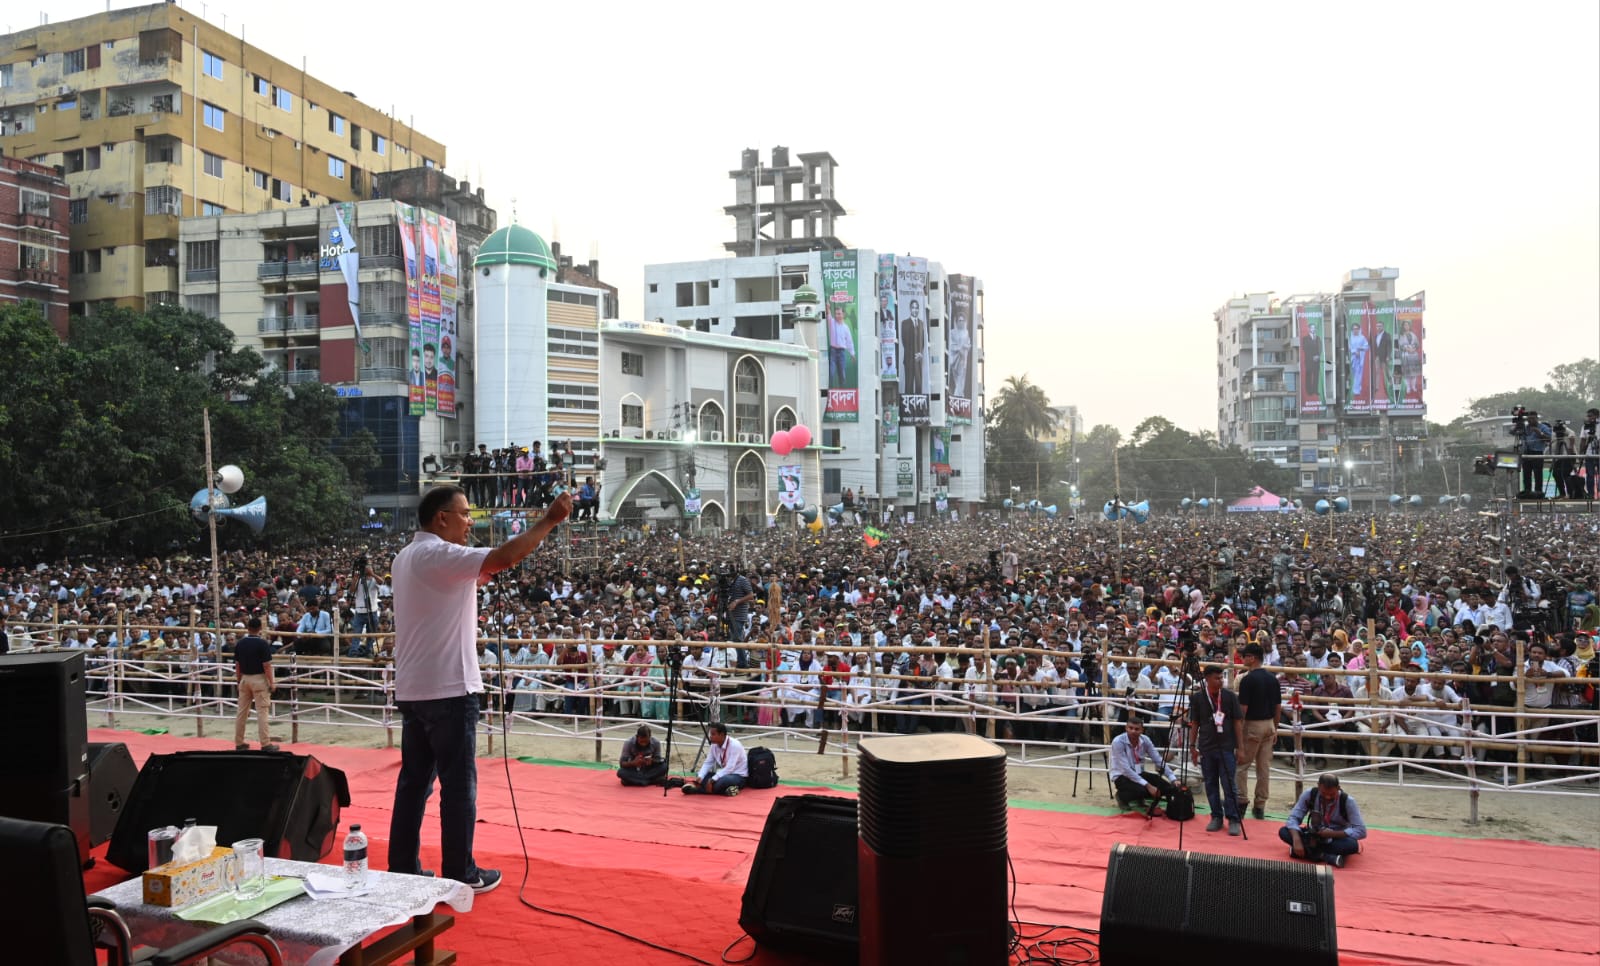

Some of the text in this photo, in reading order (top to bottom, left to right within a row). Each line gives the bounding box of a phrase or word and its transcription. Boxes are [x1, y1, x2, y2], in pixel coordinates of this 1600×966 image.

[823, 268, 855, 280] গড়বো
[1349, 308, 1366, 316] FIRM
[1367, 307, 1394, 315] LEADER
[901, 394, 927, 414] যুবদল
[949, 395, 971, 415] যুবদল
